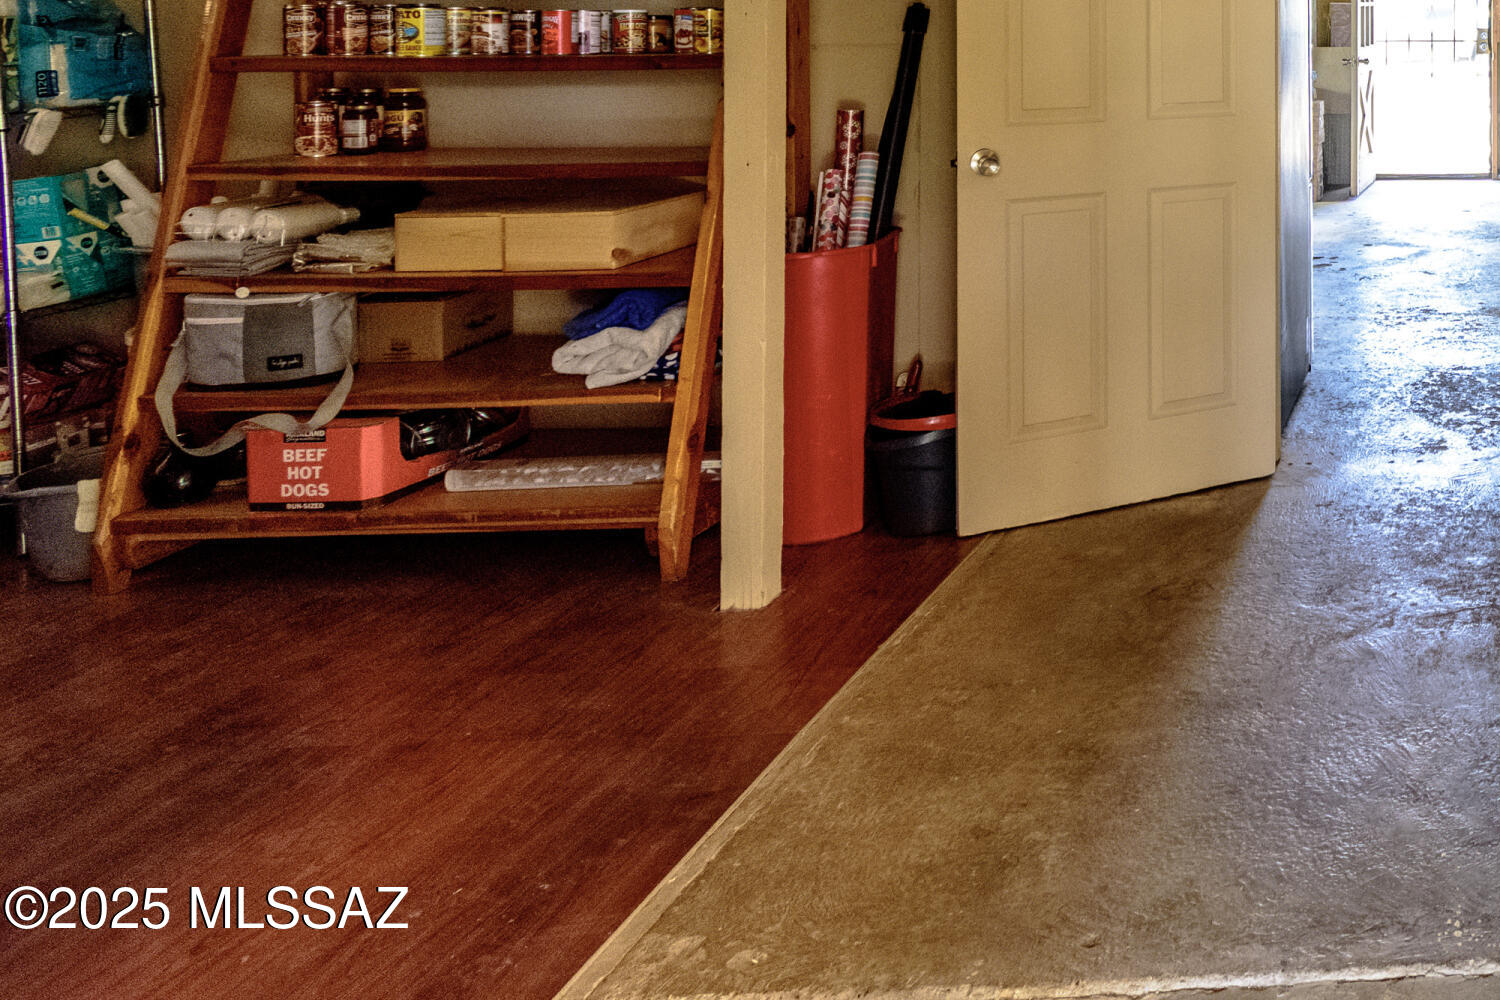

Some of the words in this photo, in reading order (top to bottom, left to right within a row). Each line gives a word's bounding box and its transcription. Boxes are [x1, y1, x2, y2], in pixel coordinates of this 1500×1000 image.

[282, 448, 328, 462] BEEF
[287, 466, 323, 480] HOT
[281, 483, 330, 497] DOGS
